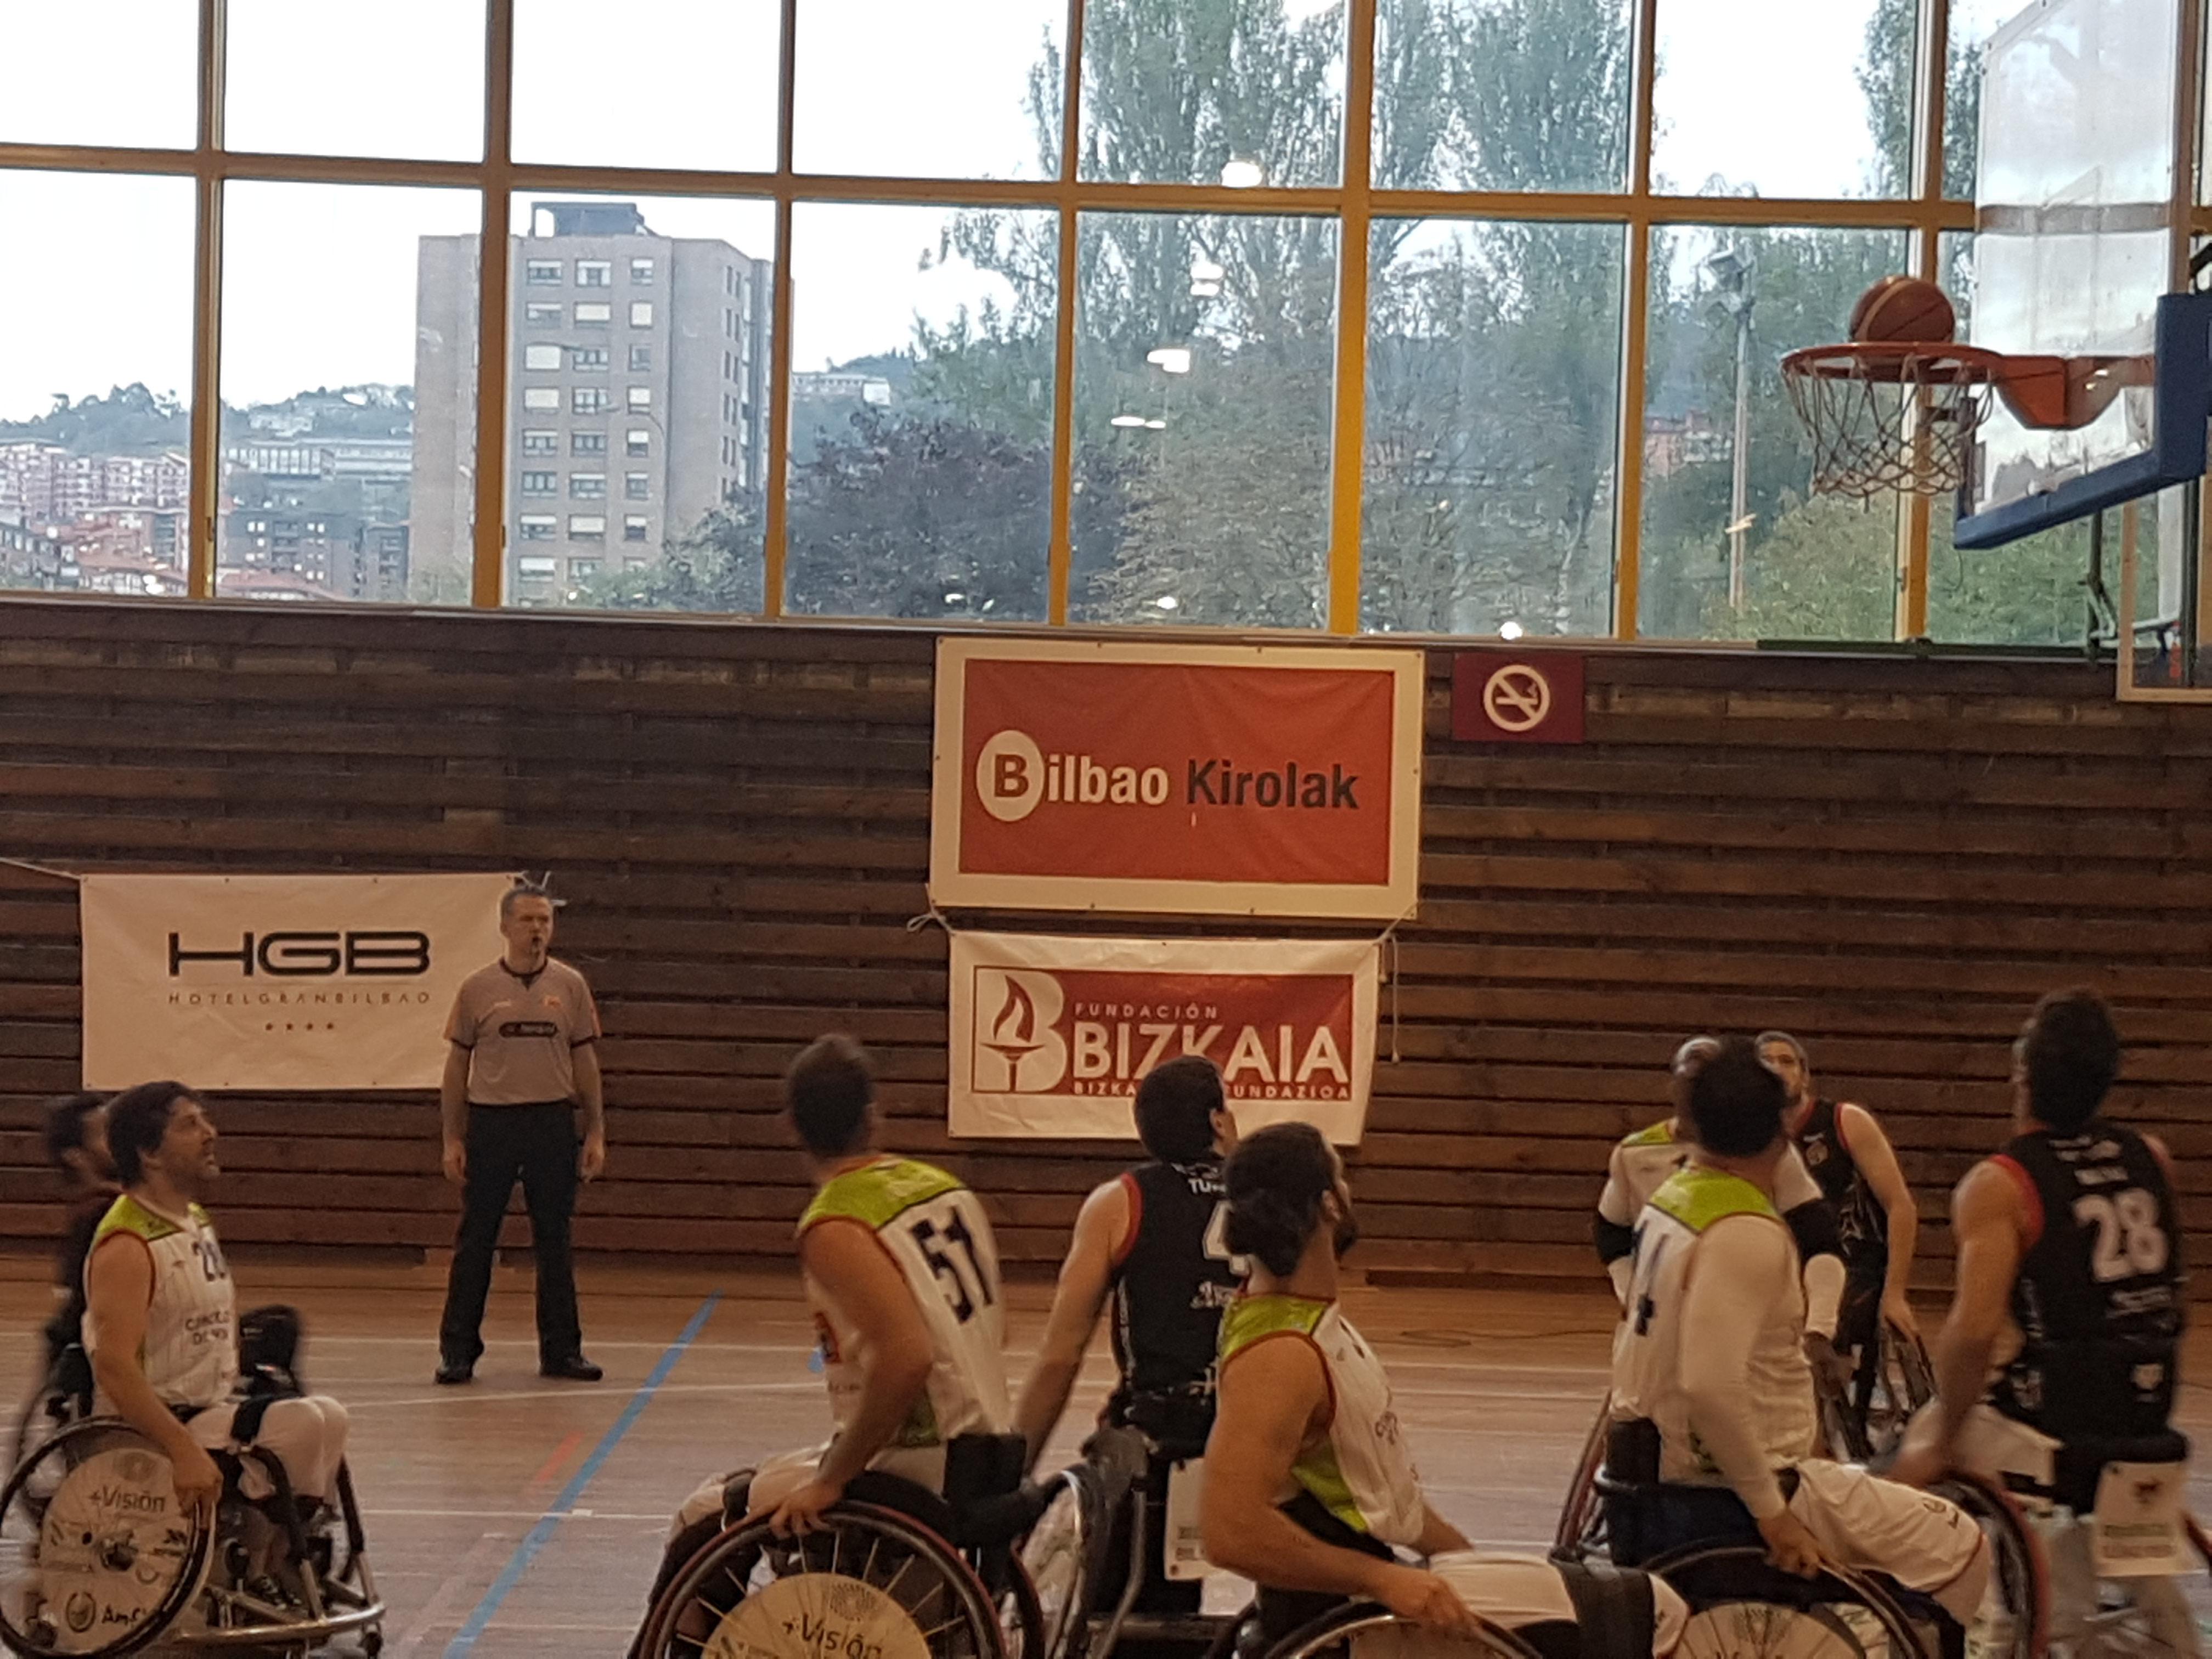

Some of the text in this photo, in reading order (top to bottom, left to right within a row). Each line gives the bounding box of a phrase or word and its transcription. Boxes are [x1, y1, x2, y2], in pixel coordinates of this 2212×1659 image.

[993, 754, 1360, 809] Bilbao Kirolak
[168, 931, 431, 977] HGB
[1074, 1003, 1217, 1019] FUNDACIÓN
[1073, 1022, 1350, 1083] BIZKAIA
[1074, 1081, 1137, 1096] BIZKA
[2071, 1187, 2170, 1284] 28
[910, 1206, 994, 1324] 51
